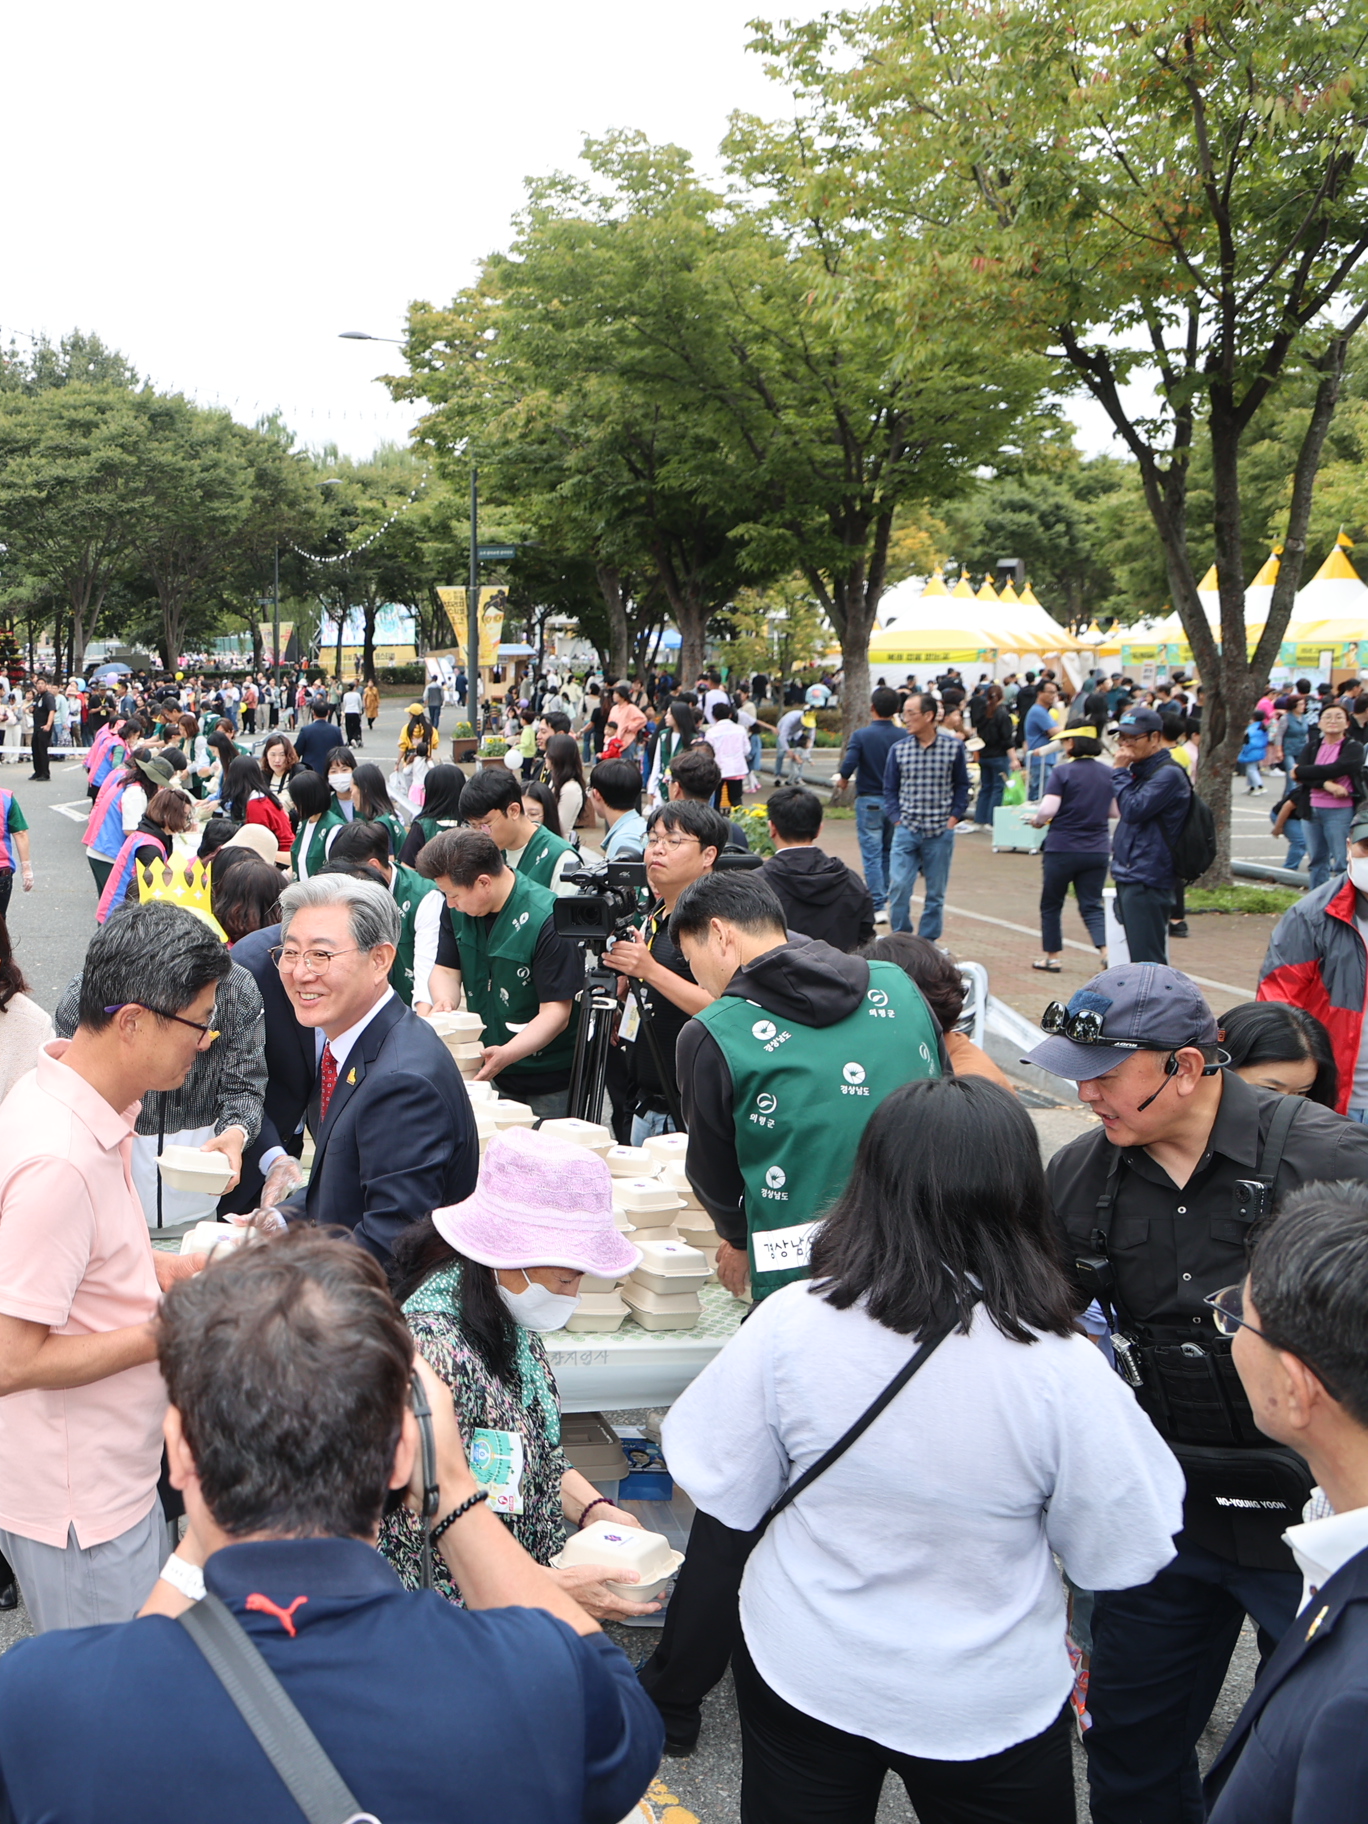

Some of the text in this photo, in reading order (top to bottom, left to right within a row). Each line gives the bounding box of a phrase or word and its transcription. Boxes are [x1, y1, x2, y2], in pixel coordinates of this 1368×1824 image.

[868, 1008, 896, 1018] 의령군
[763, 1030, 792, 1053] 경상남도
[840, 1085, 870, 1096] 경상남도
[749, 1113, 776, 1129] 의령군
[760, 1188, 789, 1201] 경상남도
[1215, 1496, 1286, 1509] HO-YOUNG YOON
